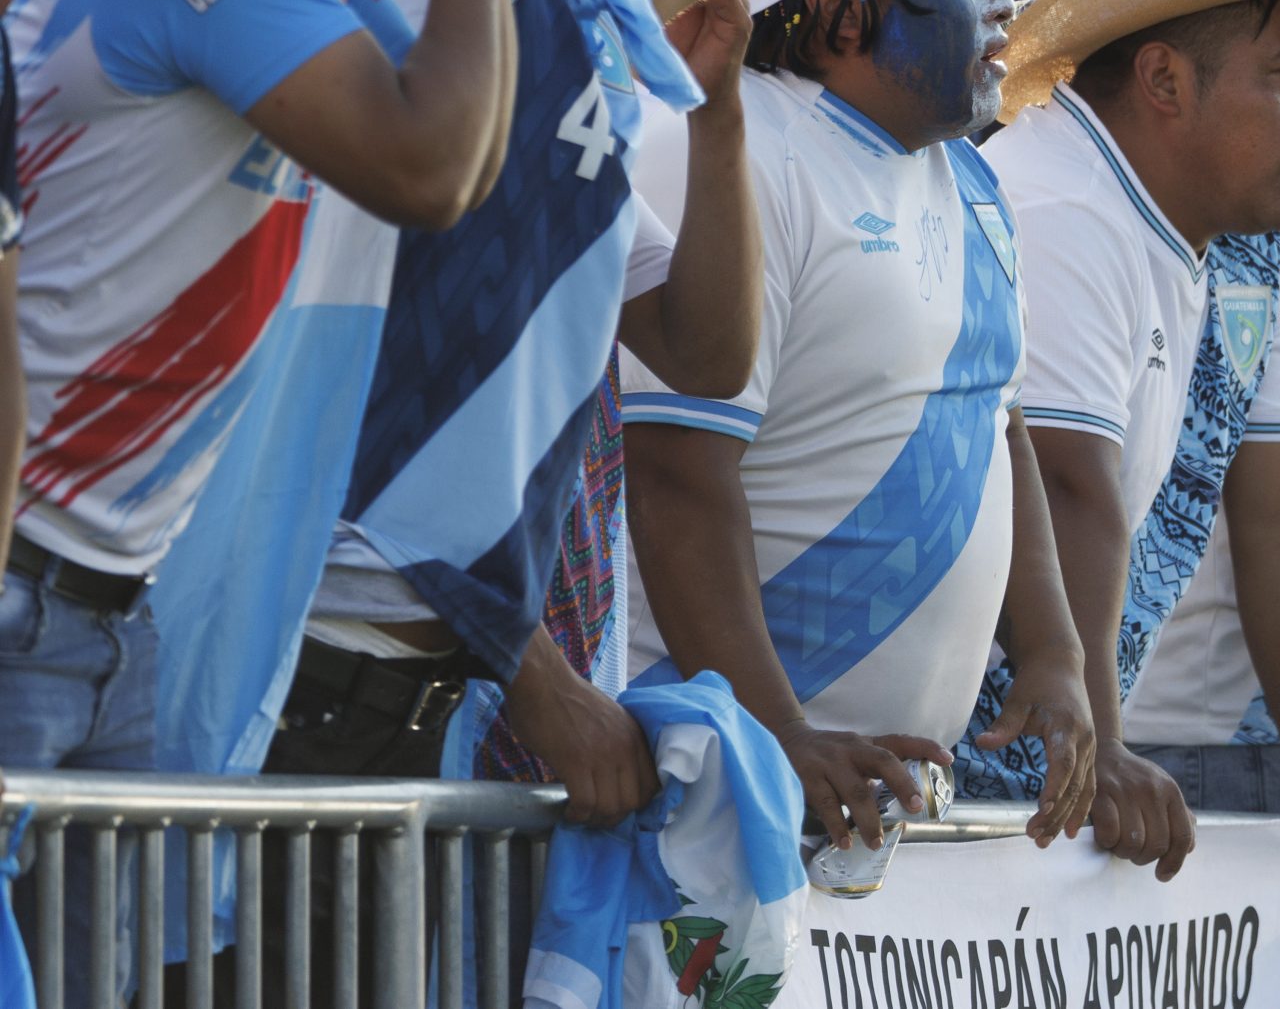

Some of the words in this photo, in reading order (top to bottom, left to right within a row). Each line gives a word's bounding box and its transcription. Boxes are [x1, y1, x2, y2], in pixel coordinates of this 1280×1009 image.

[556, 69, 616, 181] 4
[860, 236, 899, 254] umbro
[810, 906, 1067, 1009] TOTONICAPÁN
[1083, 905, 1260, 1009] APOYANDO
